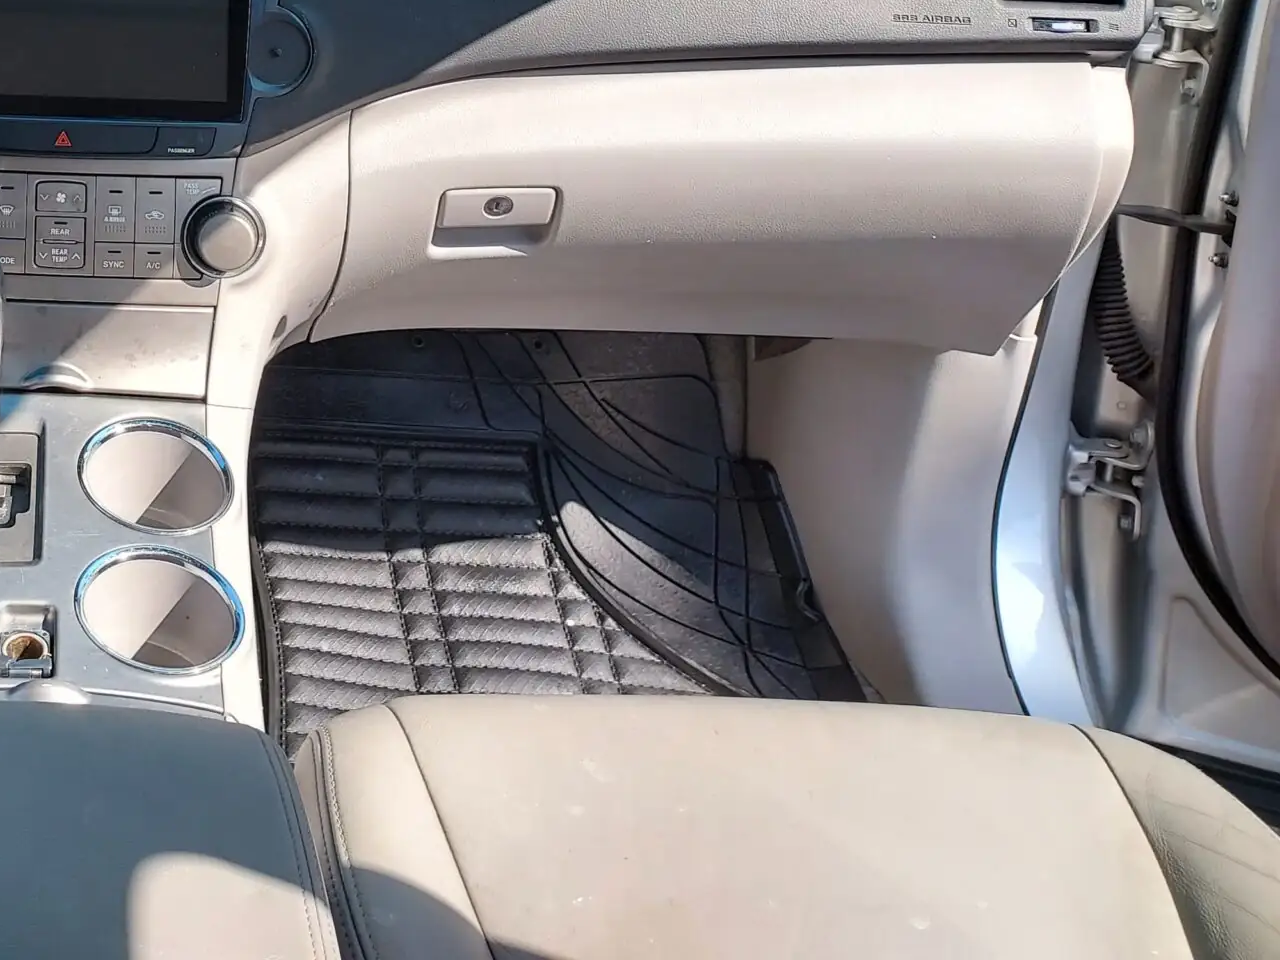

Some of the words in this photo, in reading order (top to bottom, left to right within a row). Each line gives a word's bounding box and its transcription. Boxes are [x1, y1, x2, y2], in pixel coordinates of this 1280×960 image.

[922, 14, 972, 24] AIRBAG
[50, 228, 70, 236] REAR
[51, 248, 69, 256] REAR
[0, 256, 16, 265] ODE
[51, 255, 69, 263] TEMP
[103, 260, 125, 269] SYNC
[146, 262, 161, 270] A/C
